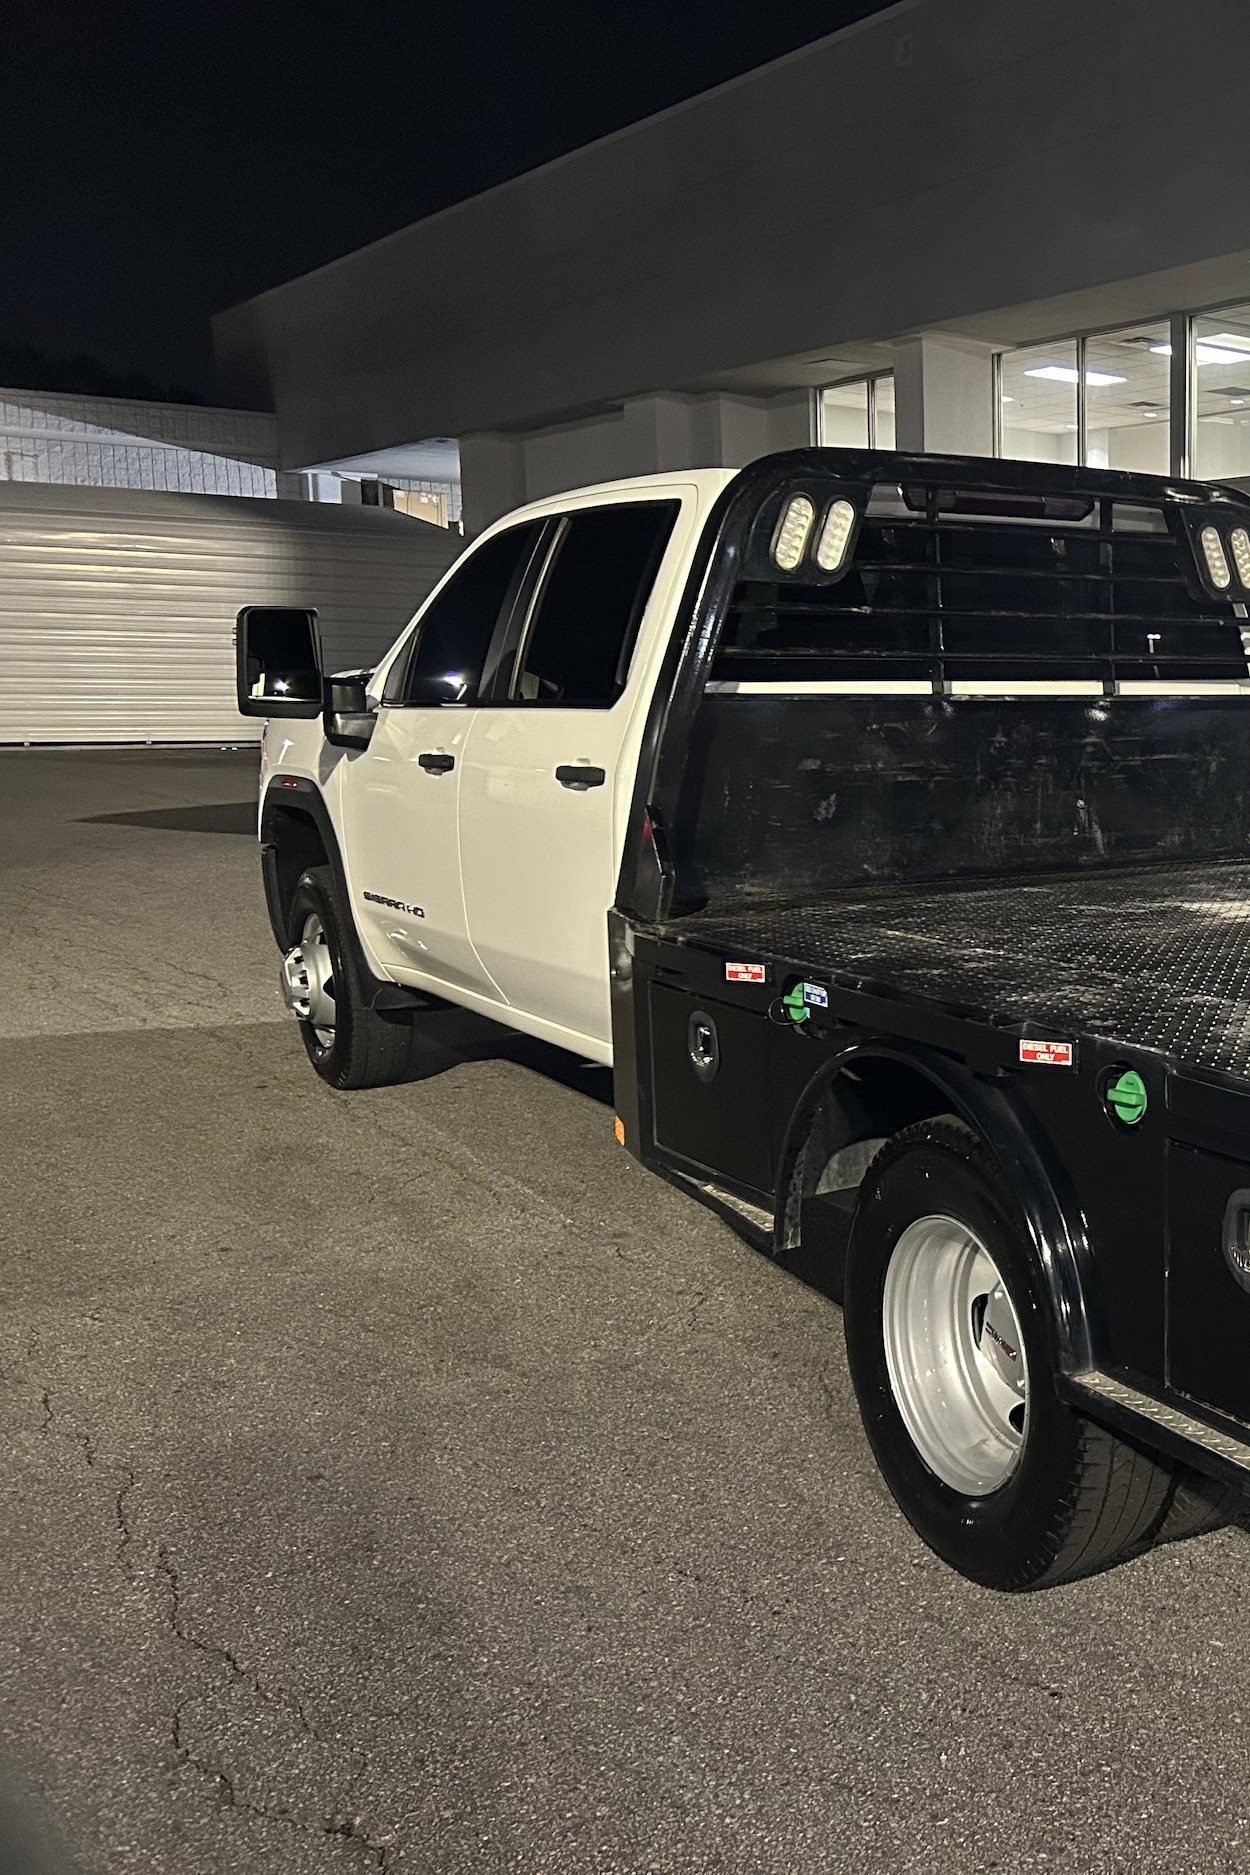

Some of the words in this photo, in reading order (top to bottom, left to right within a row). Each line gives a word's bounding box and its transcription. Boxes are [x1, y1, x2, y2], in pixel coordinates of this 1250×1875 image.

[363, 891, 406, 912] SIERRA
[407, 905, 425, 919] HD
[1022, 1043, 1049, 1052] DIESEL
[1050, 1045, 1069, 1054] FUEL
[1036, 1052, 1056, 1061] ONLY
